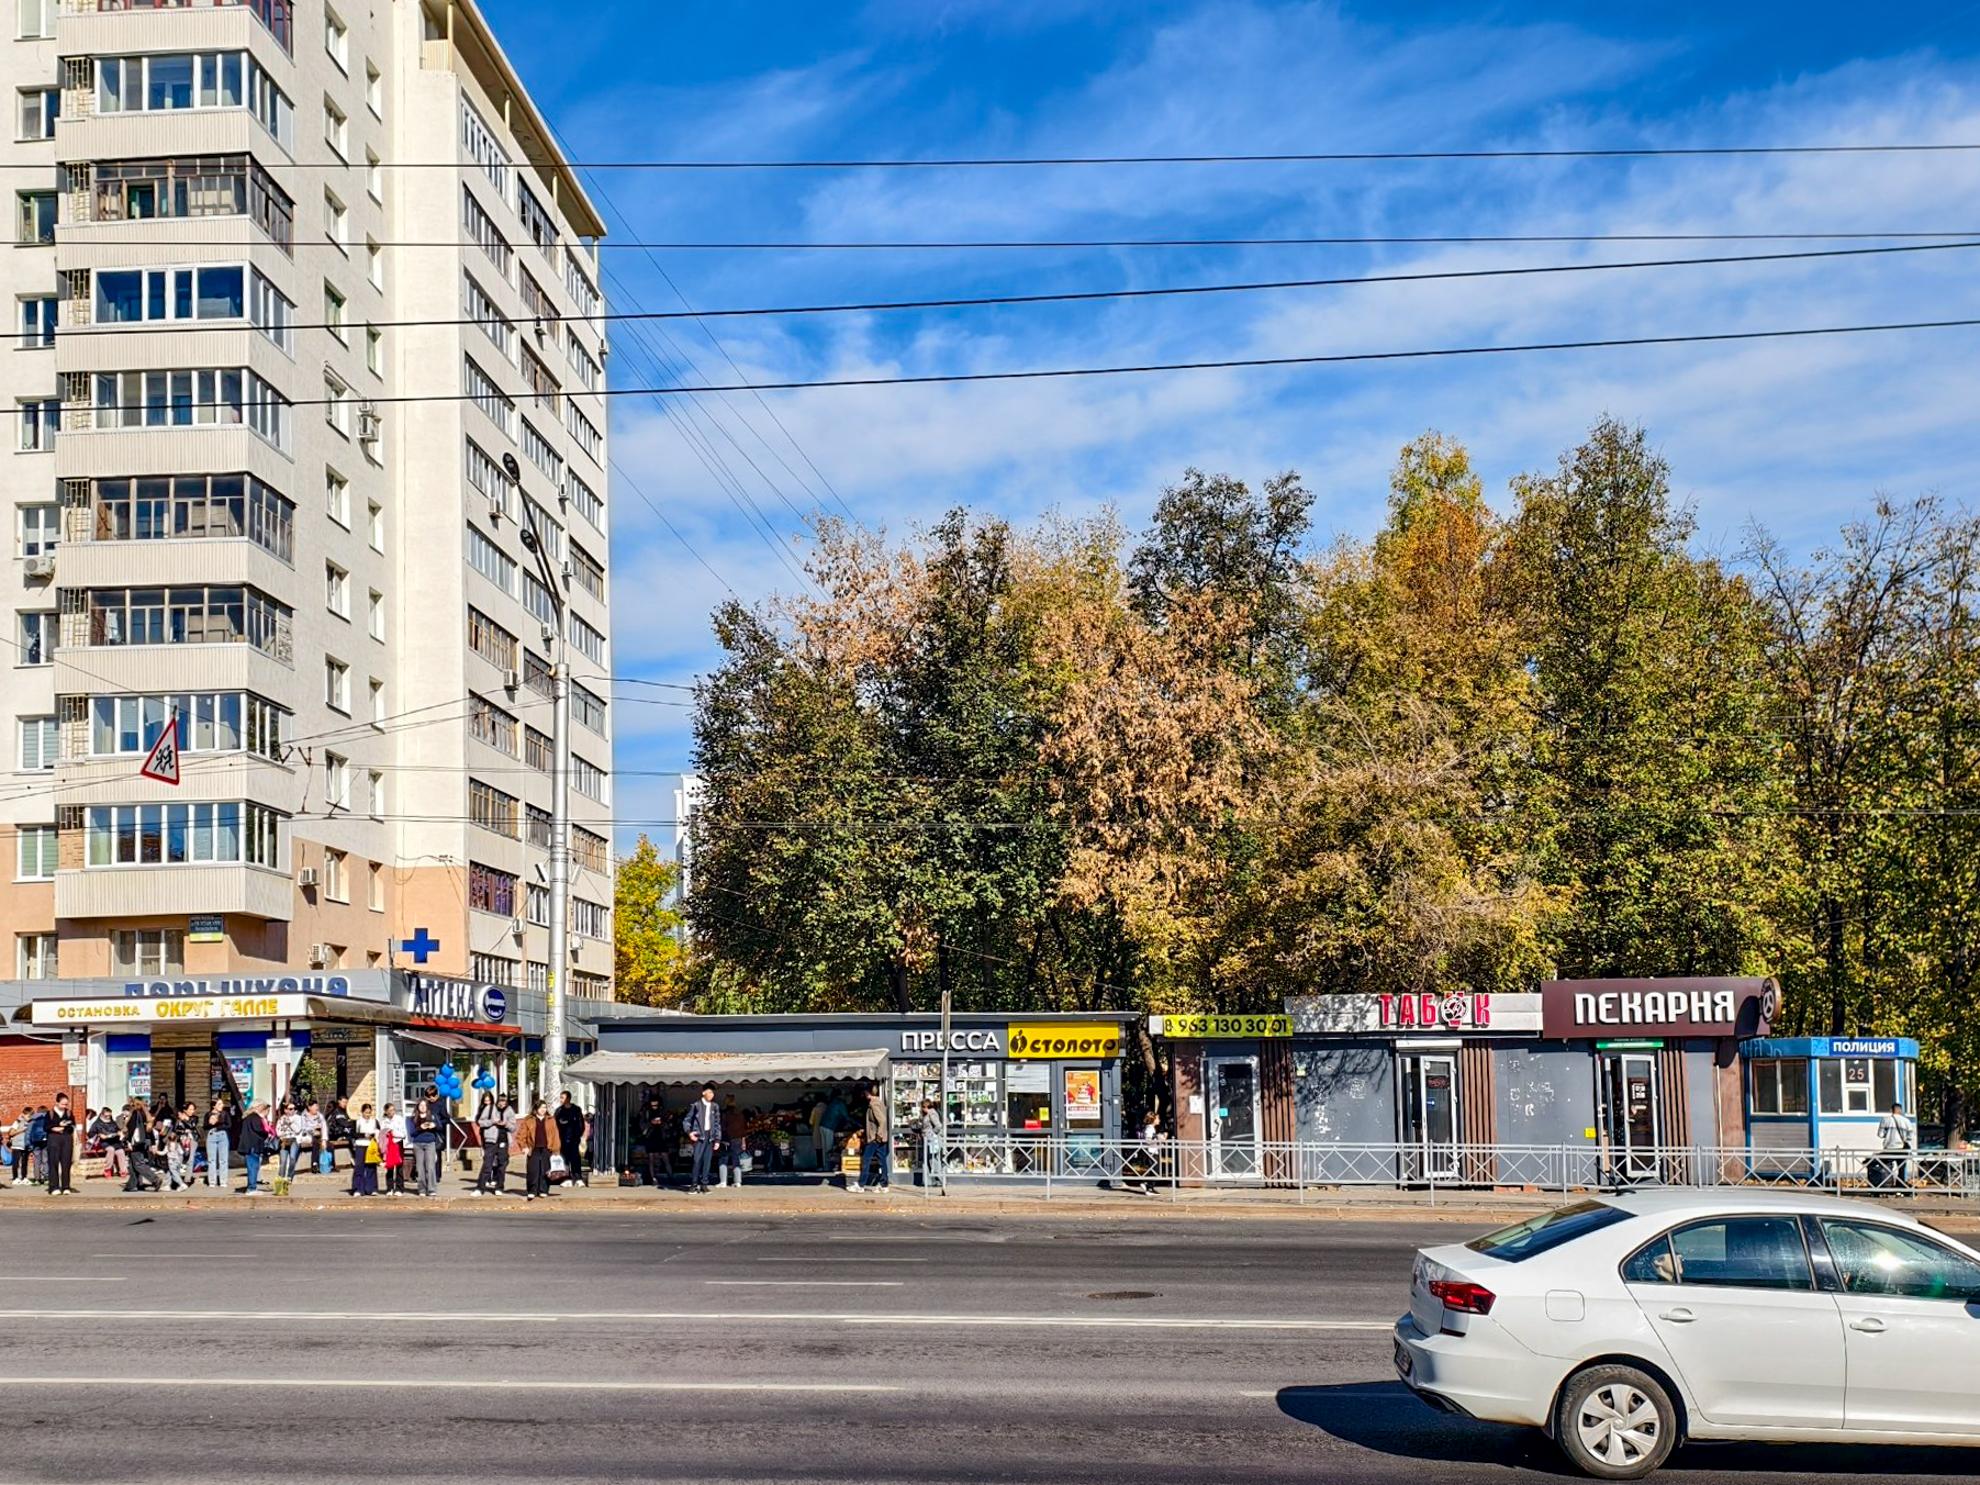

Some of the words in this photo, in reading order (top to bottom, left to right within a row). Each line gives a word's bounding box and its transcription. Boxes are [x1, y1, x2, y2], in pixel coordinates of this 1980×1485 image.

[57, 1004, 141, 1018] ОСТАНОВКА
[156, 1001, 214, 1018] ОКРУГ
[1575, 991, 1735, 1024] ПЕКАРНЯ
[1164, 1018, 1174, 1032] 8
[1178, 1018, 1208, 1033] 963
[1213, 1018, 1243, 1033] 130
[1245, 1018, 1267, 1033] 30
[902, 1031, 999, 1050] ПРЕССА
[1833, 1040, 1896, 1053] ПОЛИЦИЯ
[1848, 1067, 1865, 1081] 25
